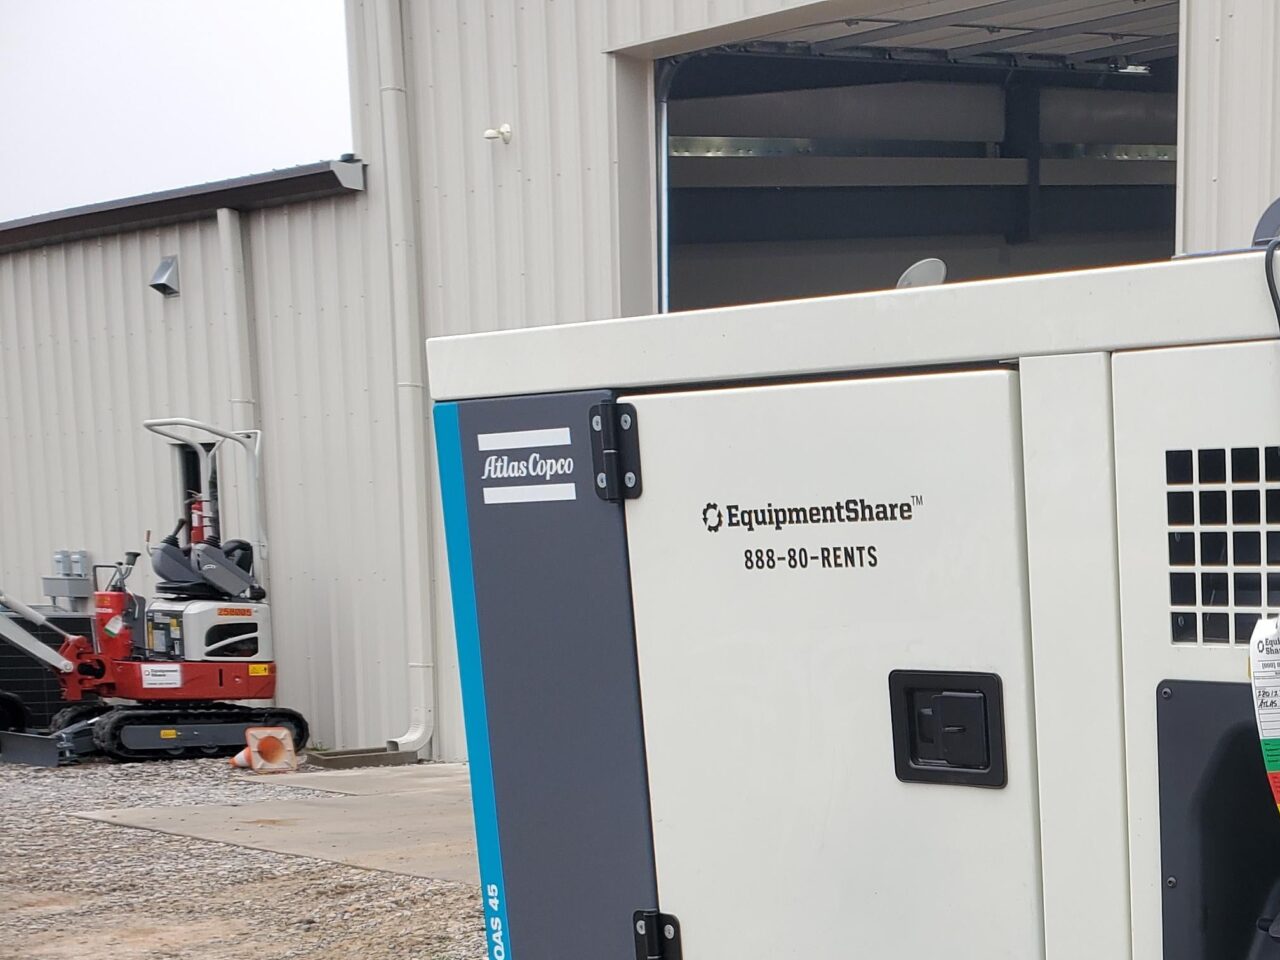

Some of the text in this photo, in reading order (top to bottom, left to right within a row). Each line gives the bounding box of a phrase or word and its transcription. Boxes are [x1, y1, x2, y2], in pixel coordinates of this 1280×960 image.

[726, 498, 913, 532] EquipmentShare
[744, 545, 879, 571] 888-80-RENTS
[487, 884, 499, 911] 45
